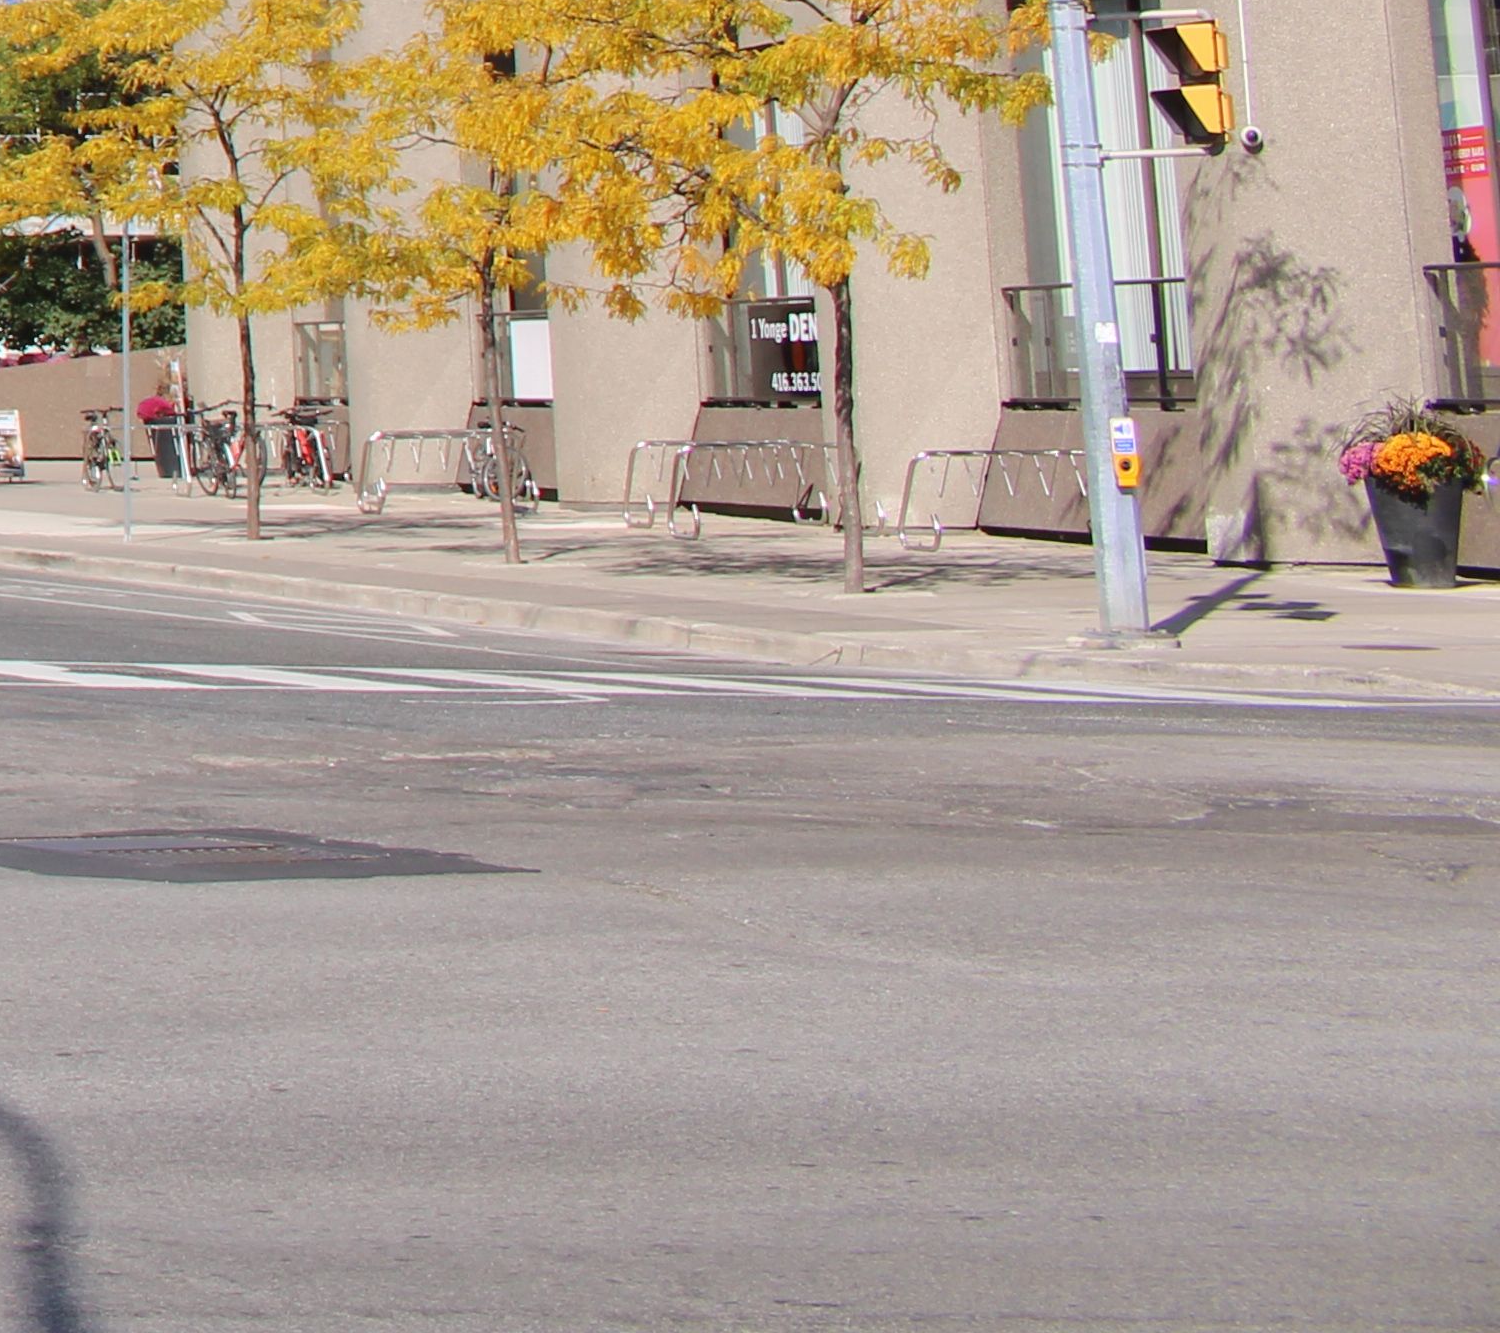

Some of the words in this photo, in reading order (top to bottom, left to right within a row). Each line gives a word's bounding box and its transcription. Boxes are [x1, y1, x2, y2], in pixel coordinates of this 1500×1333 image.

[750, 318, 757, 339] 1
[758, 318, 788, 343] Yonge
[789, 313, 818, 342] DEN
